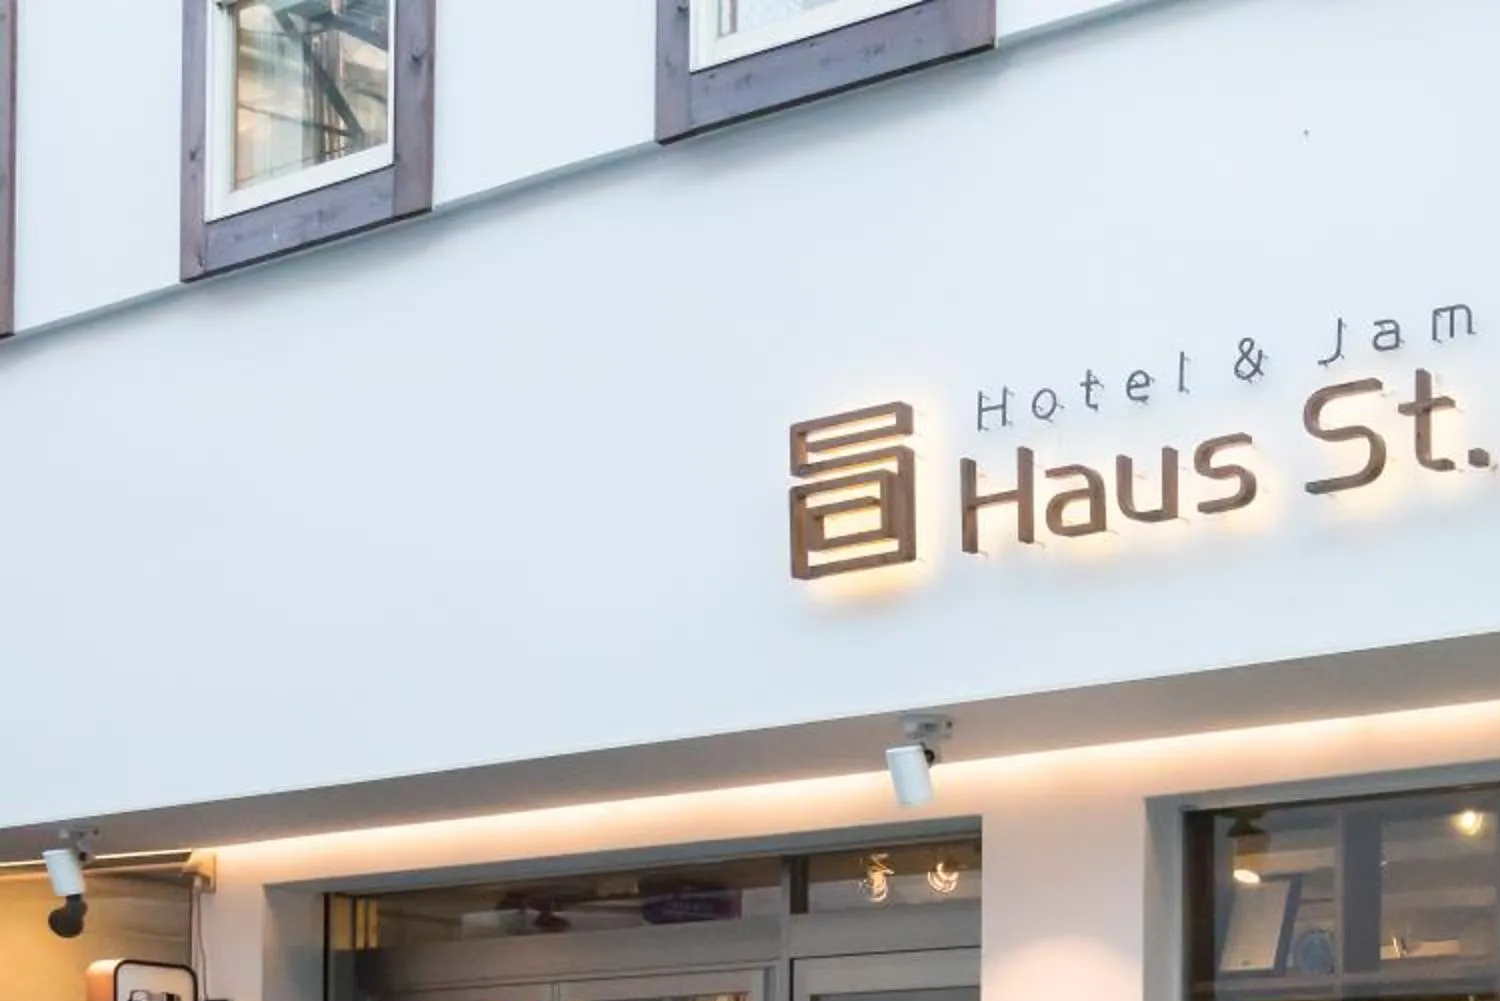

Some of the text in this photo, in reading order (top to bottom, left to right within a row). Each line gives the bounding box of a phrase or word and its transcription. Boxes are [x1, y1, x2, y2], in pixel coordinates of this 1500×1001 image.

[977, 348, 1191, 433] Hotel
[1234, 336, 1265, 378] &
[1317, 302, 1477, 368] Jam
[959, 430, 1258, 556] Haus
